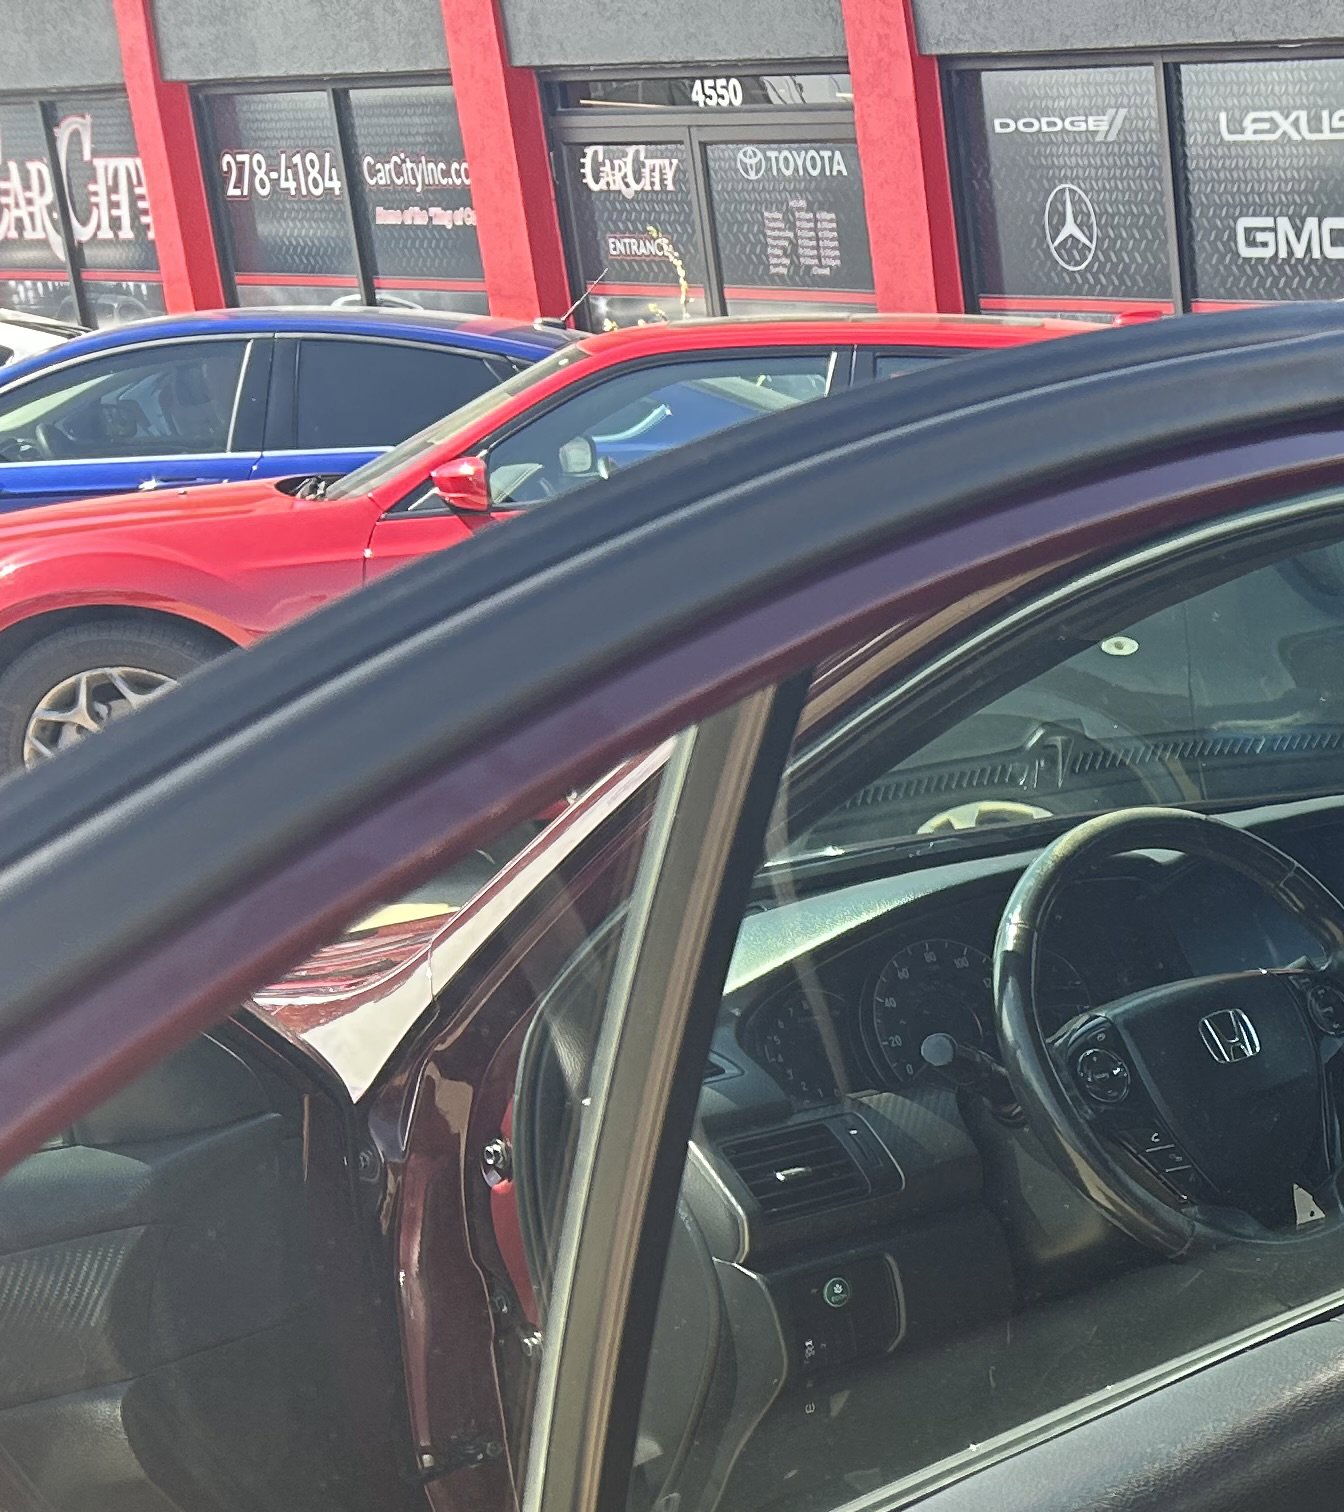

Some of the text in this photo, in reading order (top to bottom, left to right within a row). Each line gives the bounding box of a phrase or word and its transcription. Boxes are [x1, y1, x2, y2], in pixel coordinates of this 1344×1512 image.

[691, 78, 743, 108] 4550
[993, 115, 1110, 134] DODGE
[221, 151, 343, 198] 278-4184
[766, 149, 848, 176] TOYOTA
[608, 237, 673, 257] ENTRANC
